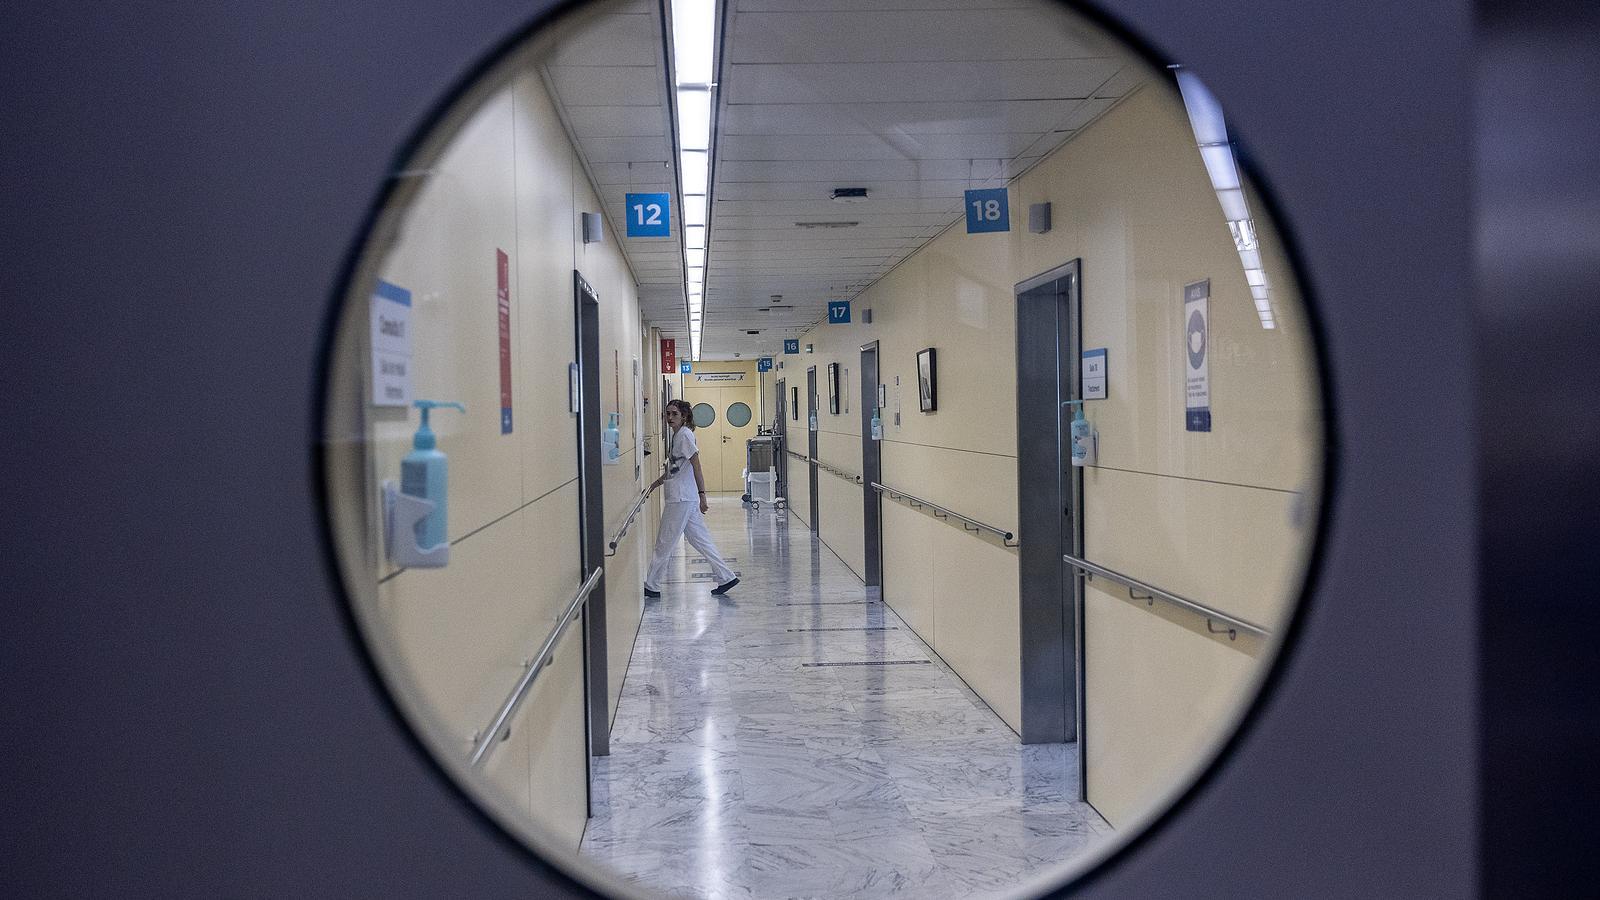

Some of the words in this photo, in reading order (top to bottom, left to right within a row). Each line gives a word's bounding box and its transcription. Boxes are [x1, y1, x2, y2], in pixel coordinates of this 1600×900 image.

[633, 203, 662, 225] 12
[972, 200, 1000, 221] 18
[831, 306, 846, 318] 17
[786, 342, 797, 351] 16
